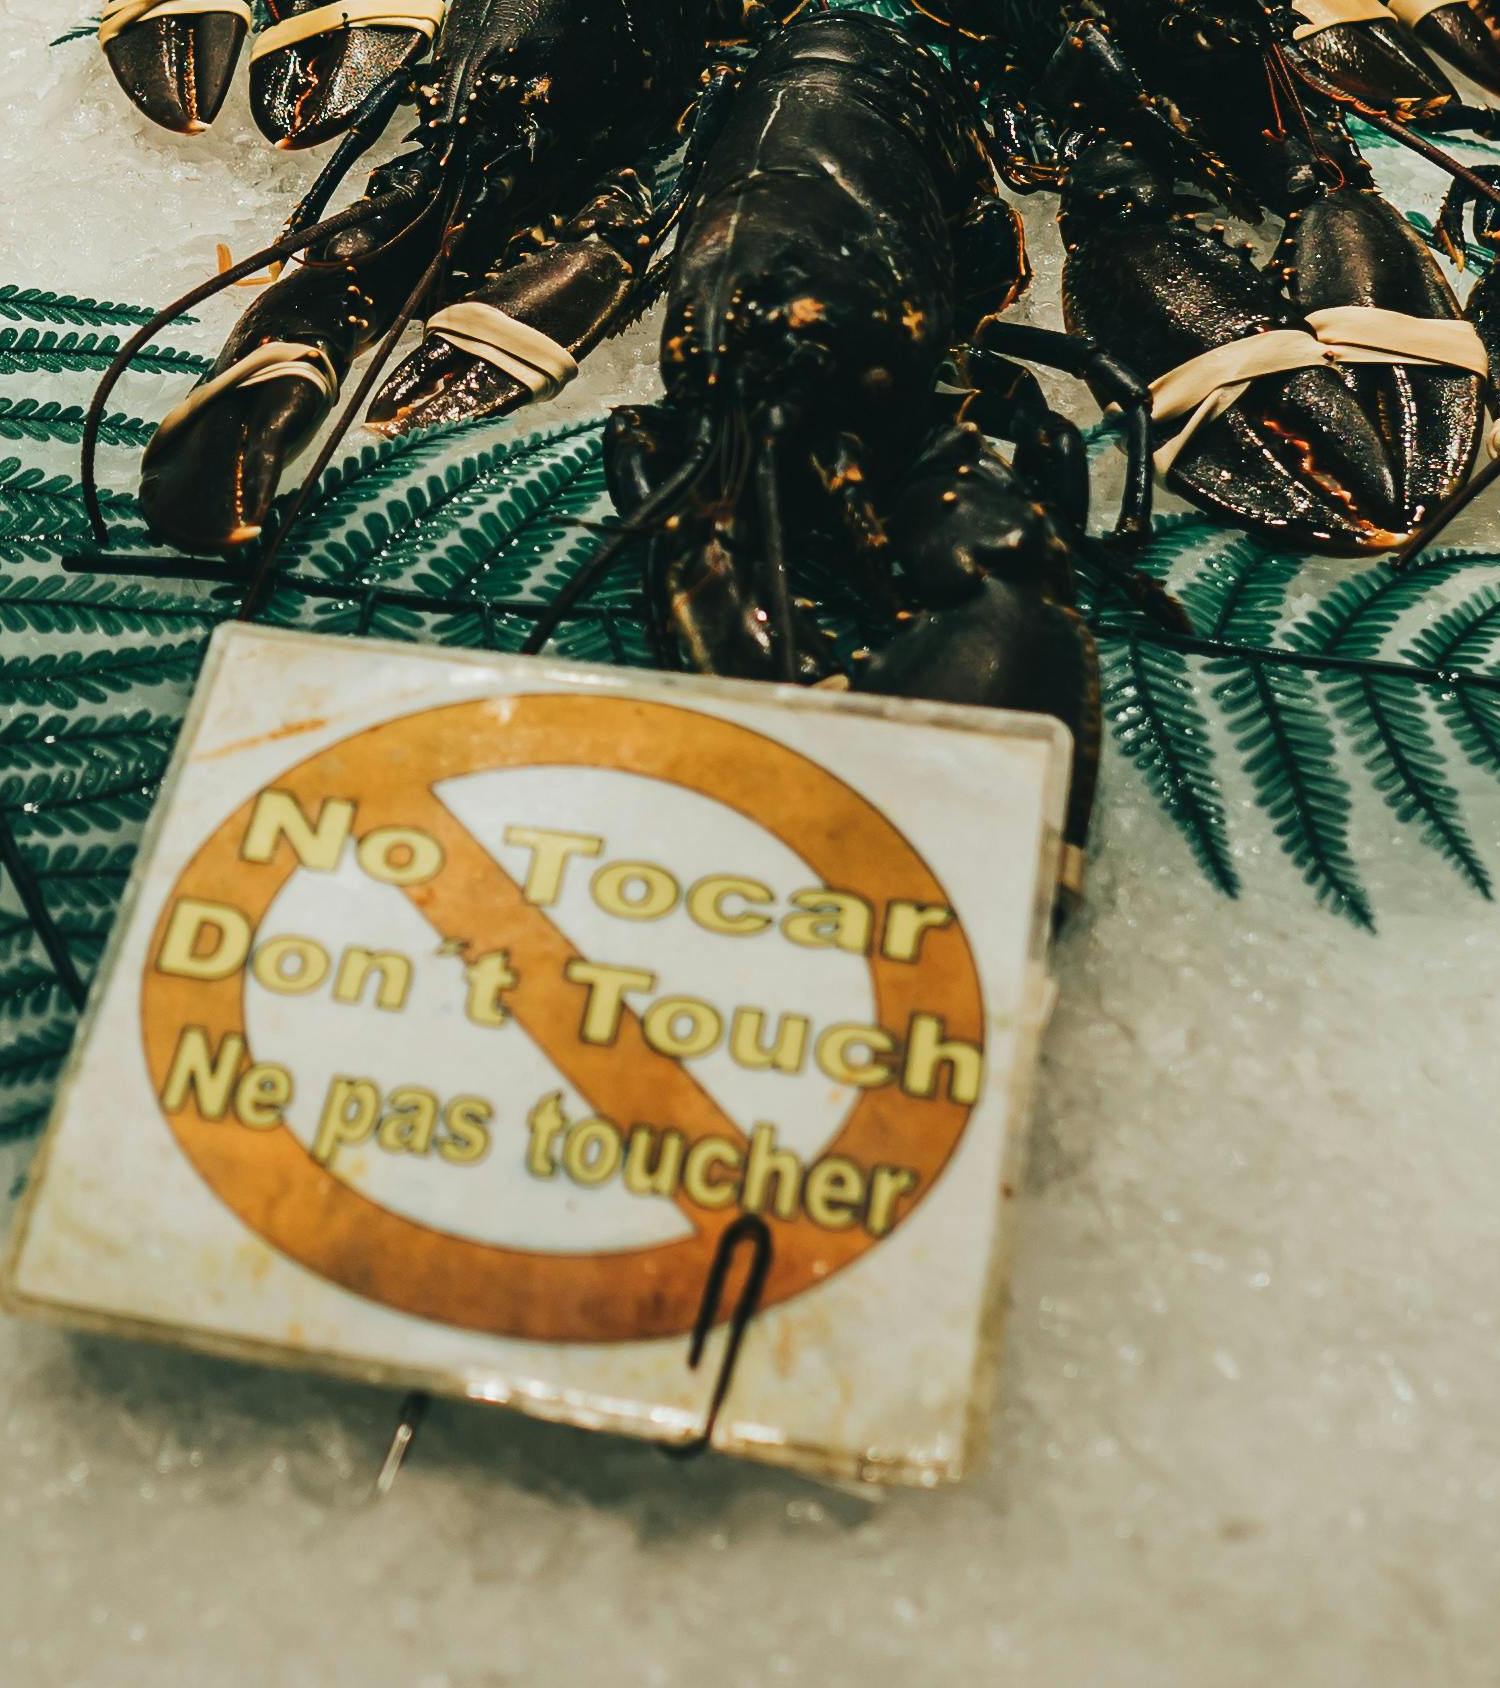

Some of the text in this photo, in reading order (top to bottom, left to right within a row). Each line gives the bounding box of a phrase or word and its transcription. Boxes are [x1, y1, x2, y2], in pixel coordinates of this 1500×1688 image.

[241, 788, 955, 970] No Tocar
[566, 957, 983, 1105] Touch
[163, 1025, 916, 1240] Ne pas toucher
